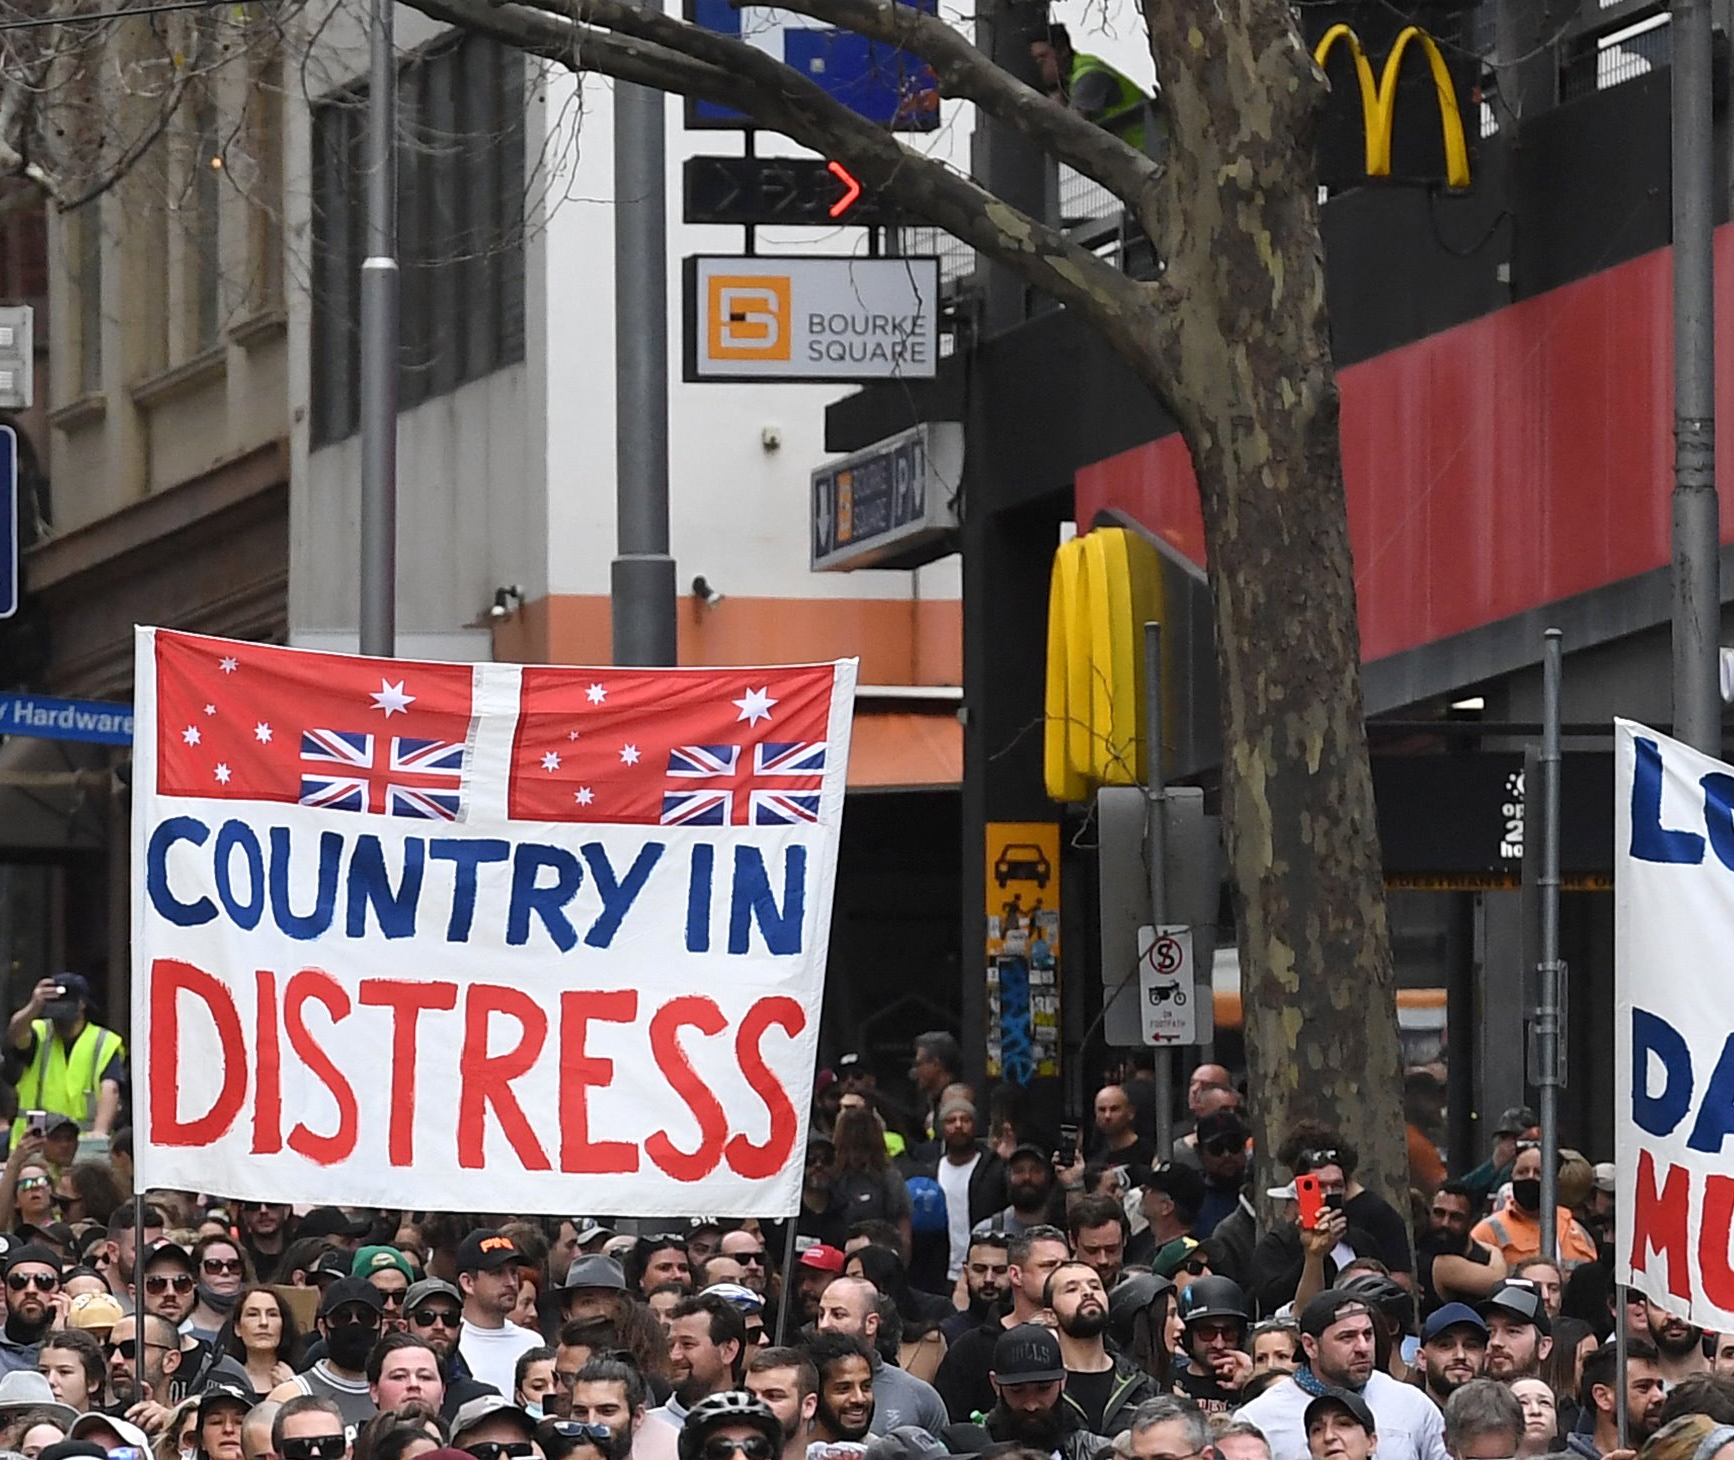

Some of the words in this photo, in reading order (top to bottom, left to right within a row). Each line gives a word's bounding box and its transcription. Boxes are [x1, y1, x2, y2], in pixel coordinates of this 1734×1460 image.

[808, 313, 927, 337] BOURKE
[808, 340, 927, 364] SQUARE
[146, 816, 665, 952] COUNTRY
[686, 843, 807, 955] IN
[148, 959, 806, 1182] DISTRESS
